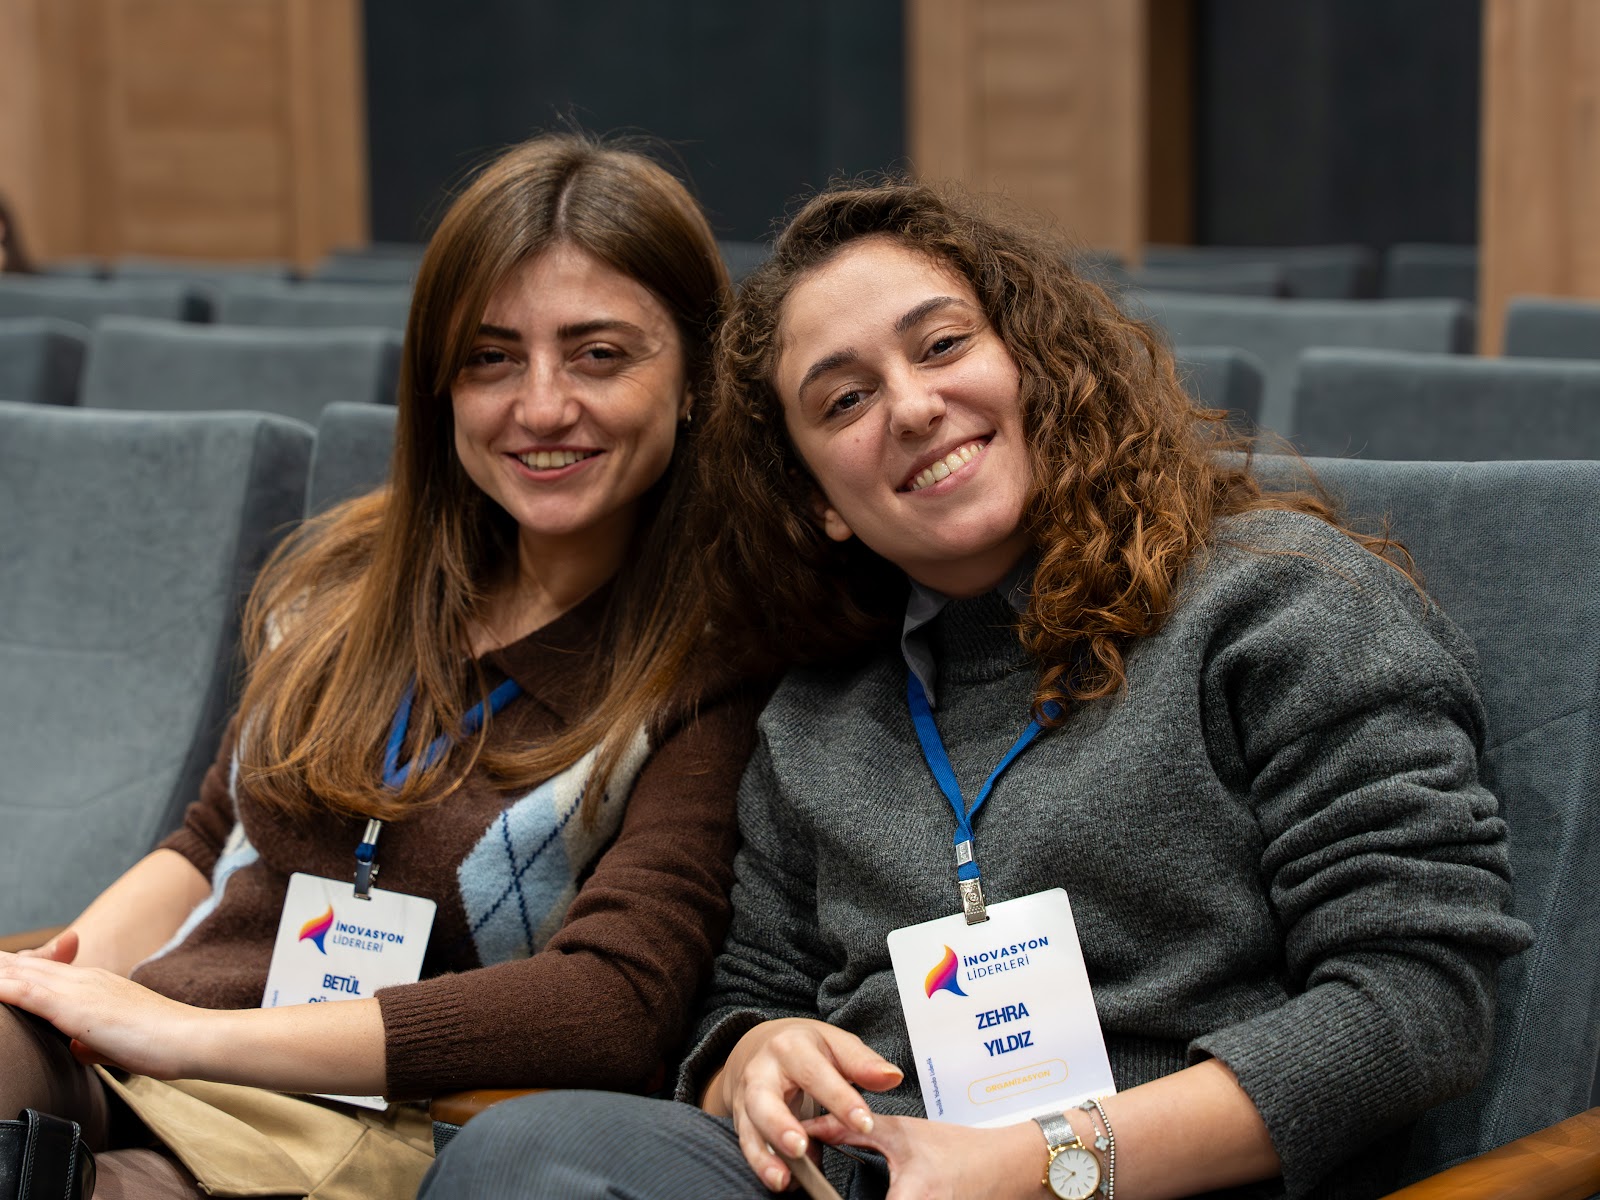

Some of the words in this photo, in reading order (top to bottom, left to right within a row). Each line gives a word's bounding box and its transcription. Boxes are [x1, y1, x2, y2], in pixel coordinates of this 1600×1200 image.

[333, 935, 383, 953] LİDERLERİ
[335, 920, 404, 944] İNOVASYON
[963, 936, 1049, 967] İNOVASYON
[967, 954, 1030, 981] LİDERLERİ
[323, 973, 361, 995] BETÜL
[975, 1002, 1029, 1030] ZEHRA
[984, 1030, 1034, 1057] YILDIZ
